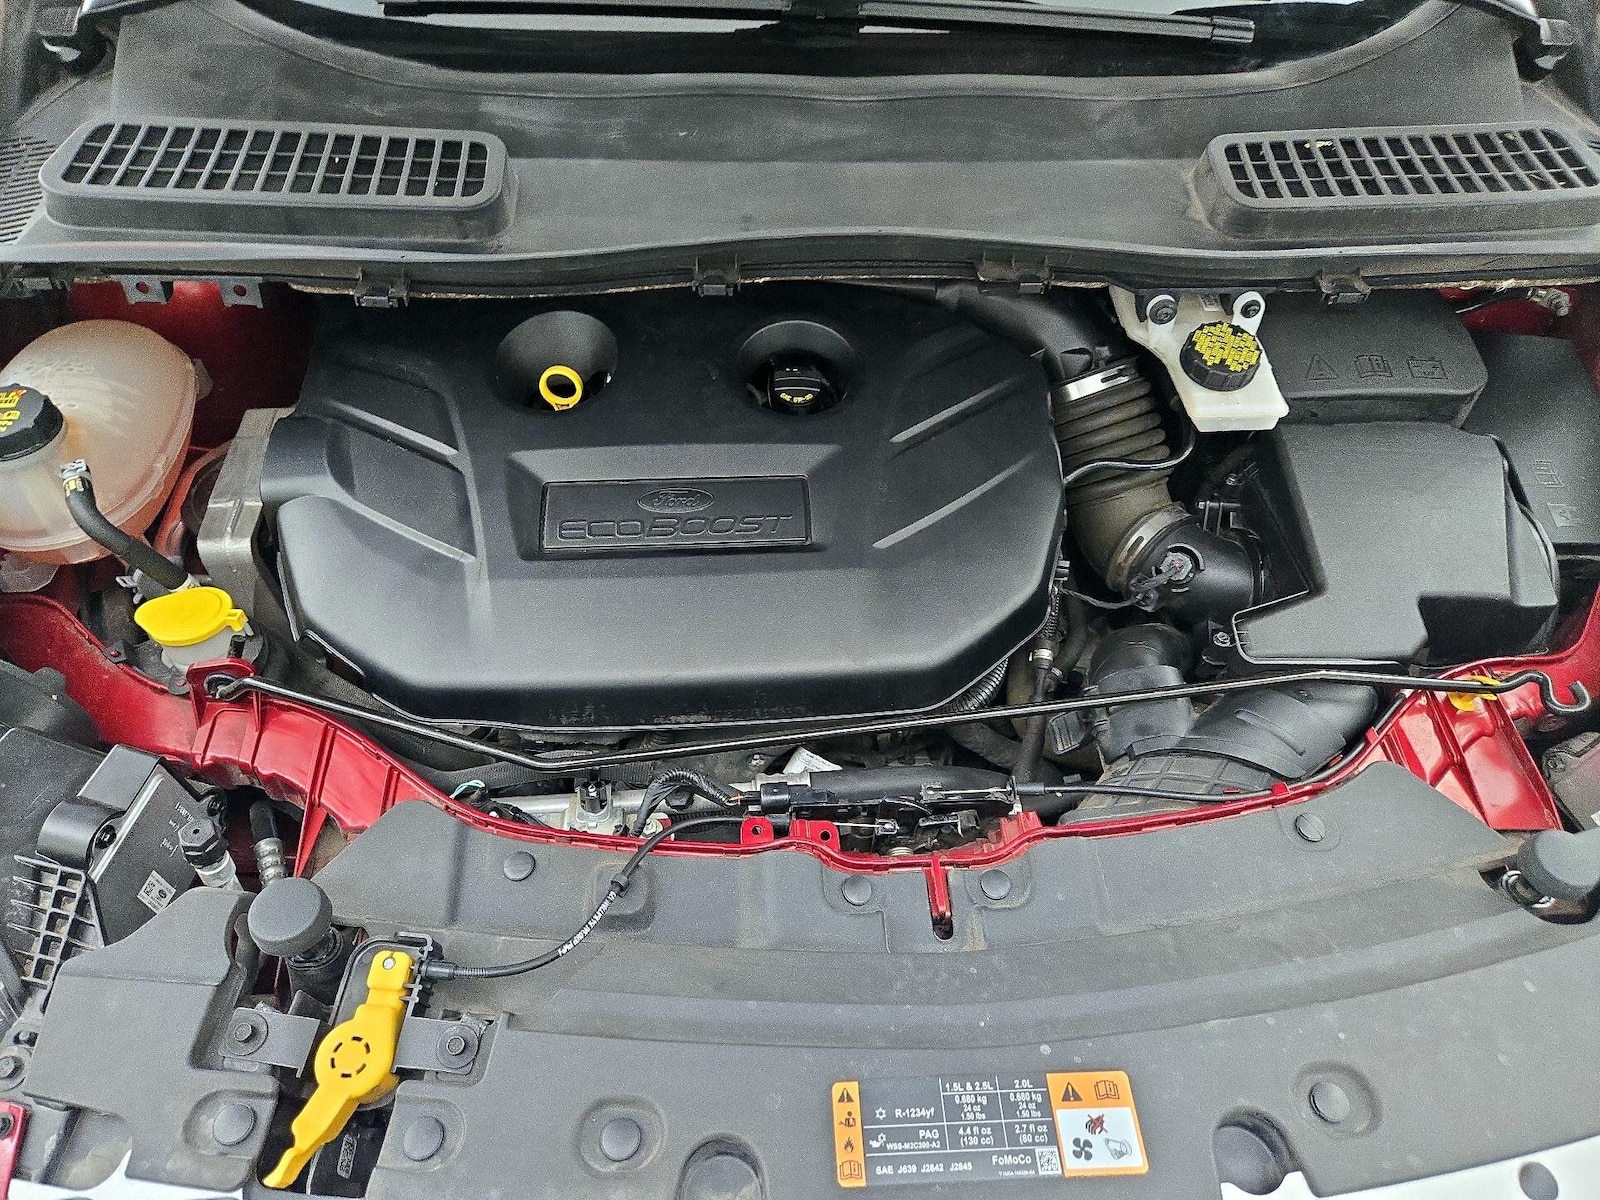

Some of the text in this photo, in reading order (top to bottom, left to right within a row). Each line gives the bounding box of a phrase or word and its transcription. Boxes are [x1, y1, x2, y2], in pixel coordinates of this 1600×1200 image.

[557, 515, 793, 541] ECOBOOST
[945, 1082, 964, 1092] 1.5L
[965, 1081, 973, 1091] &
[1013, 1079, 1033, 1089] 2.0L
[954, 1094, 987, 1105] 0.680 kg
[1009, 1092, 1042, 1102] 0.680 kg
[963, 1104, 972, 1112] 24
[1018, 1102, 1027, 1110] 24
[894, 1106, 935, 1119] R-1234yf
[960, 1112, 986, 1120] 1.50 lbs
[1016, 1110, 1042, 1118] 1.50 lbs
[918, 1129, 940, 1140] PAG
[958, 1125, 992, 1136] 4.4 fl oz
[1014, 1124, 1048, 1134] 2.7 fl oz
[960, 1135, 994, 1147] (130 cc)
[1019, 1133, 1048, 1145] (80 cc)
[991, 1153, 1032, 1166] FoMoCo
[875, 1161, 973, 1175] SAE J639 J2842 J2845
